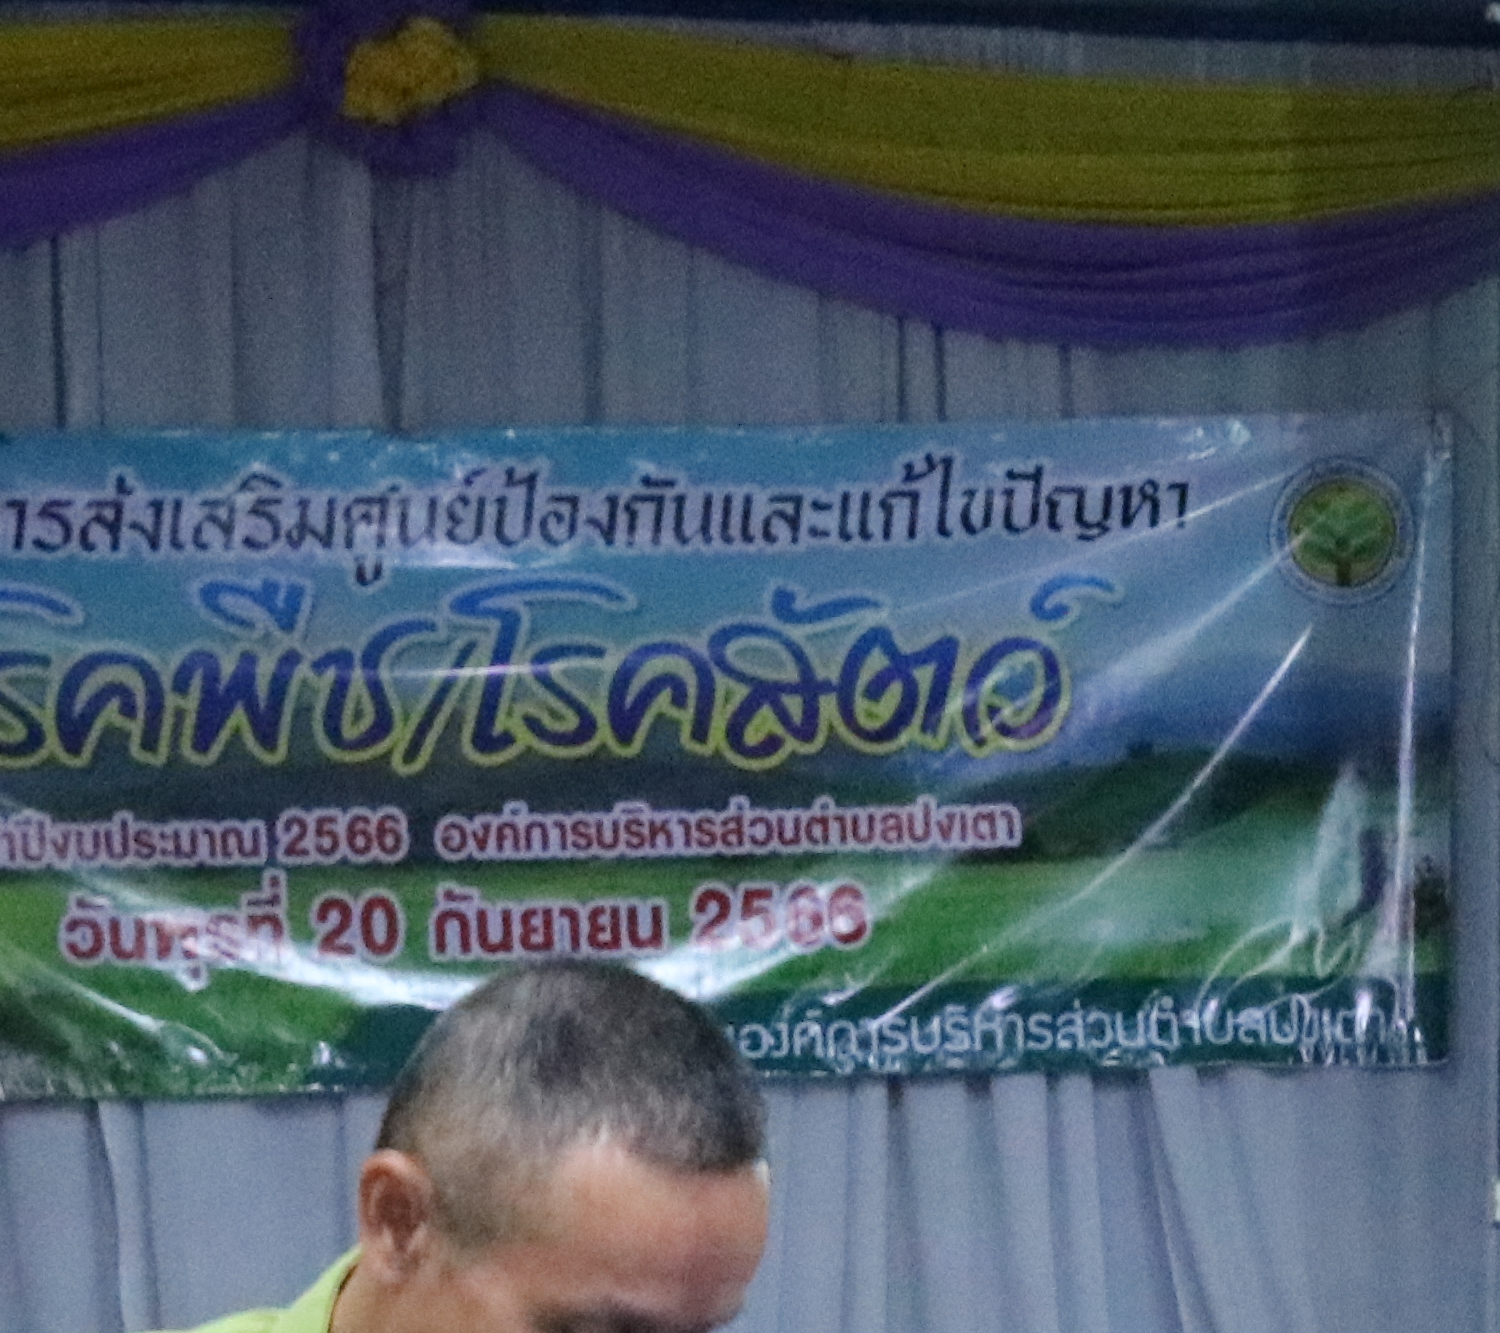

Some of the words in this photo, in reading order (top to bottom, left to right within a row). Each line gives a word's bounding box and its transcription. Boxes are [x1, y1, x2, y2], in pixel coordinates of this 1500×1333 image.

[277, 808, 407, 862] 2566
[437, 797, 1022, 860] องค์การบริหารส่วนตำบลปงเตา
[315, 895, 402, 959] 20
[431, 884, 668, 959] กันยายน
[694, 880, 871, 949] 2566
